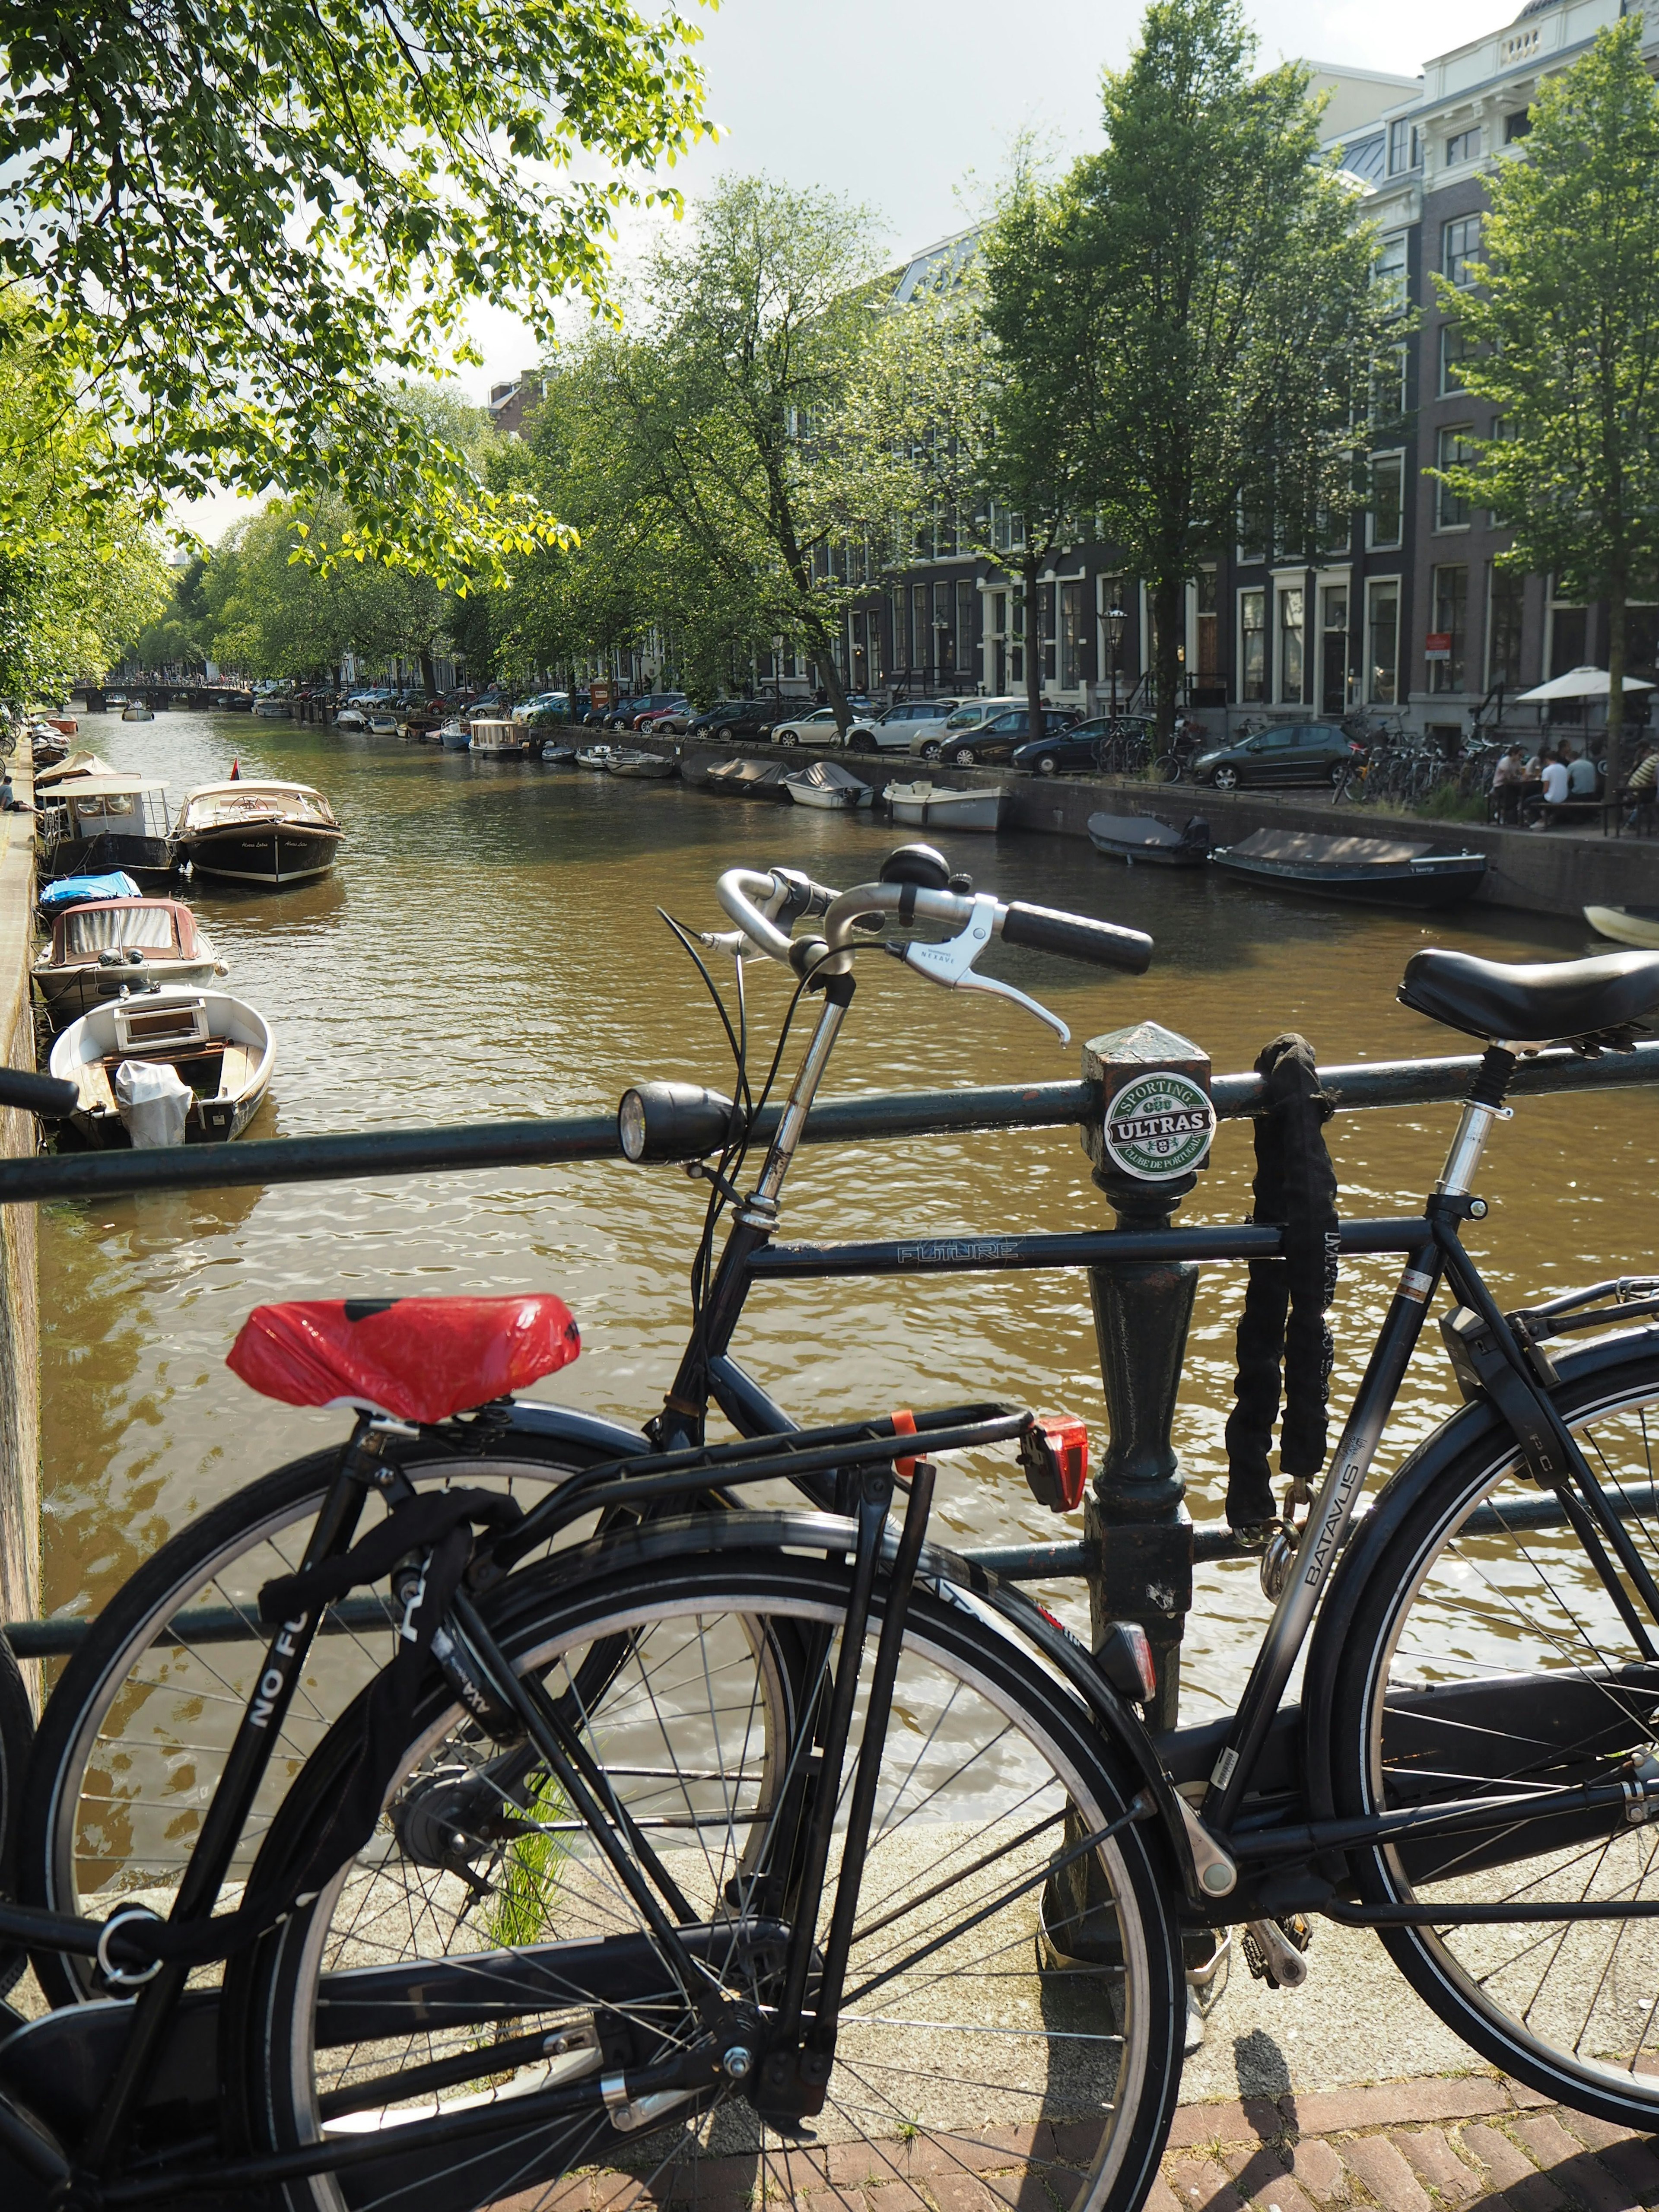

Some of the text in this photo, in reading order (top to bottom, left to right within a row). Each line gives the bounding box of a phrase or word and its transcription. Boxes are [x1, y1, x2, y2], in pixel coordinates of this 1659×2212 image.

[921, 951, 954, 964] NEXAVE
[1121, 1081, 1193, 1112] SPORTING
[1118, 1113, 1204, 1140] ULTRAS
[1125, 1148, 1149, 1167] CLUBE
[1164, 1138, 1201, 1168] PORTUGAL
[897, 1243, 1018, 1263] FUTURE
[1304, 1463, 1360, 1586] BATAVUS
[249, 1669, 284, 1729] NO
[463, 1681, 491, 1713] AXA
